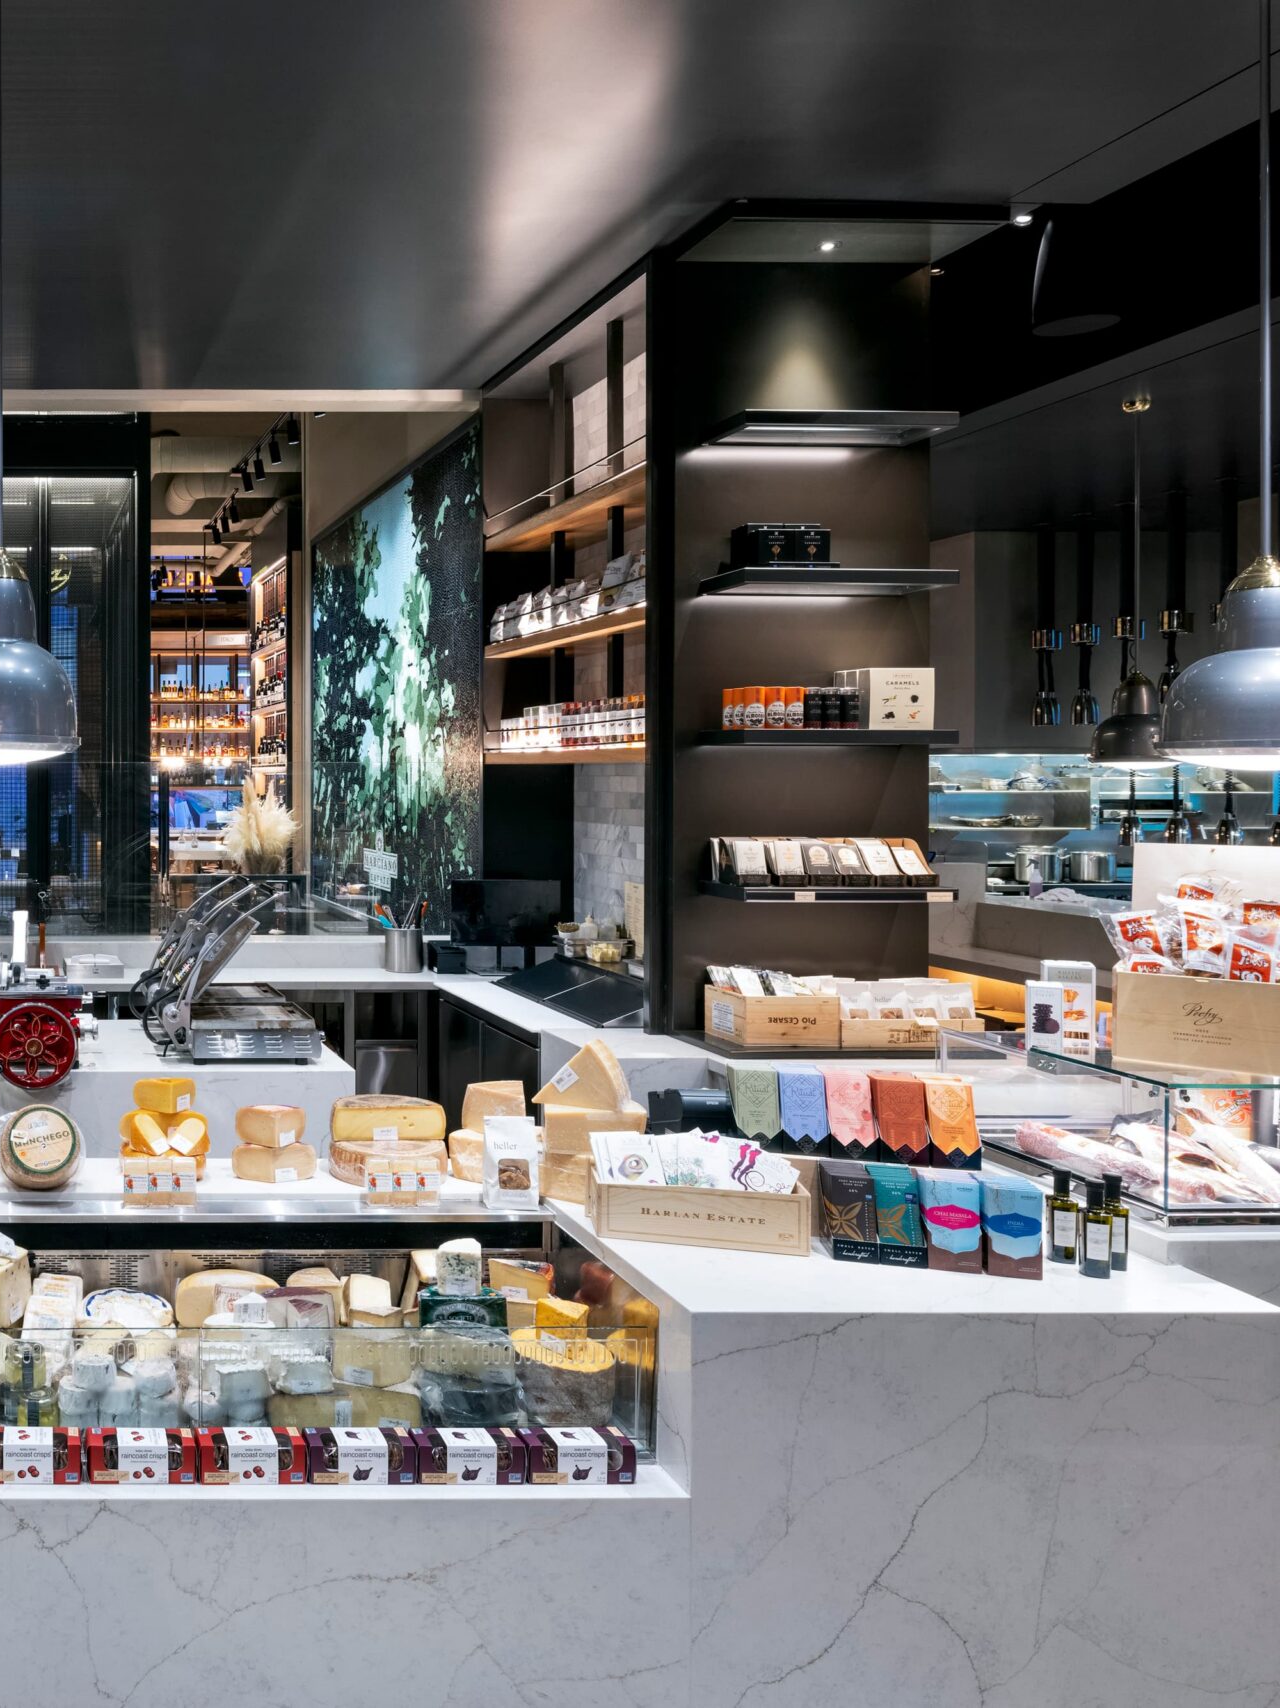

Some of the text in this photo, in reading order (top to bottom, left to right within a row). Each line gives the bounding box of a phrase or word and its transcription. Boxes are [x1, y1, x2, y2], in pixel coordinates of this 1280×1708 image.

[767, 1017, 817, 1025] PIO CESARE
[14, 1130, 70, 1148] MANCHEGO
[493, 1141, 518, 1150] heller
[641, 1207, 766, 1225] HARLAN ESTATE
[949, 1211, 972, 1219] MASALA
